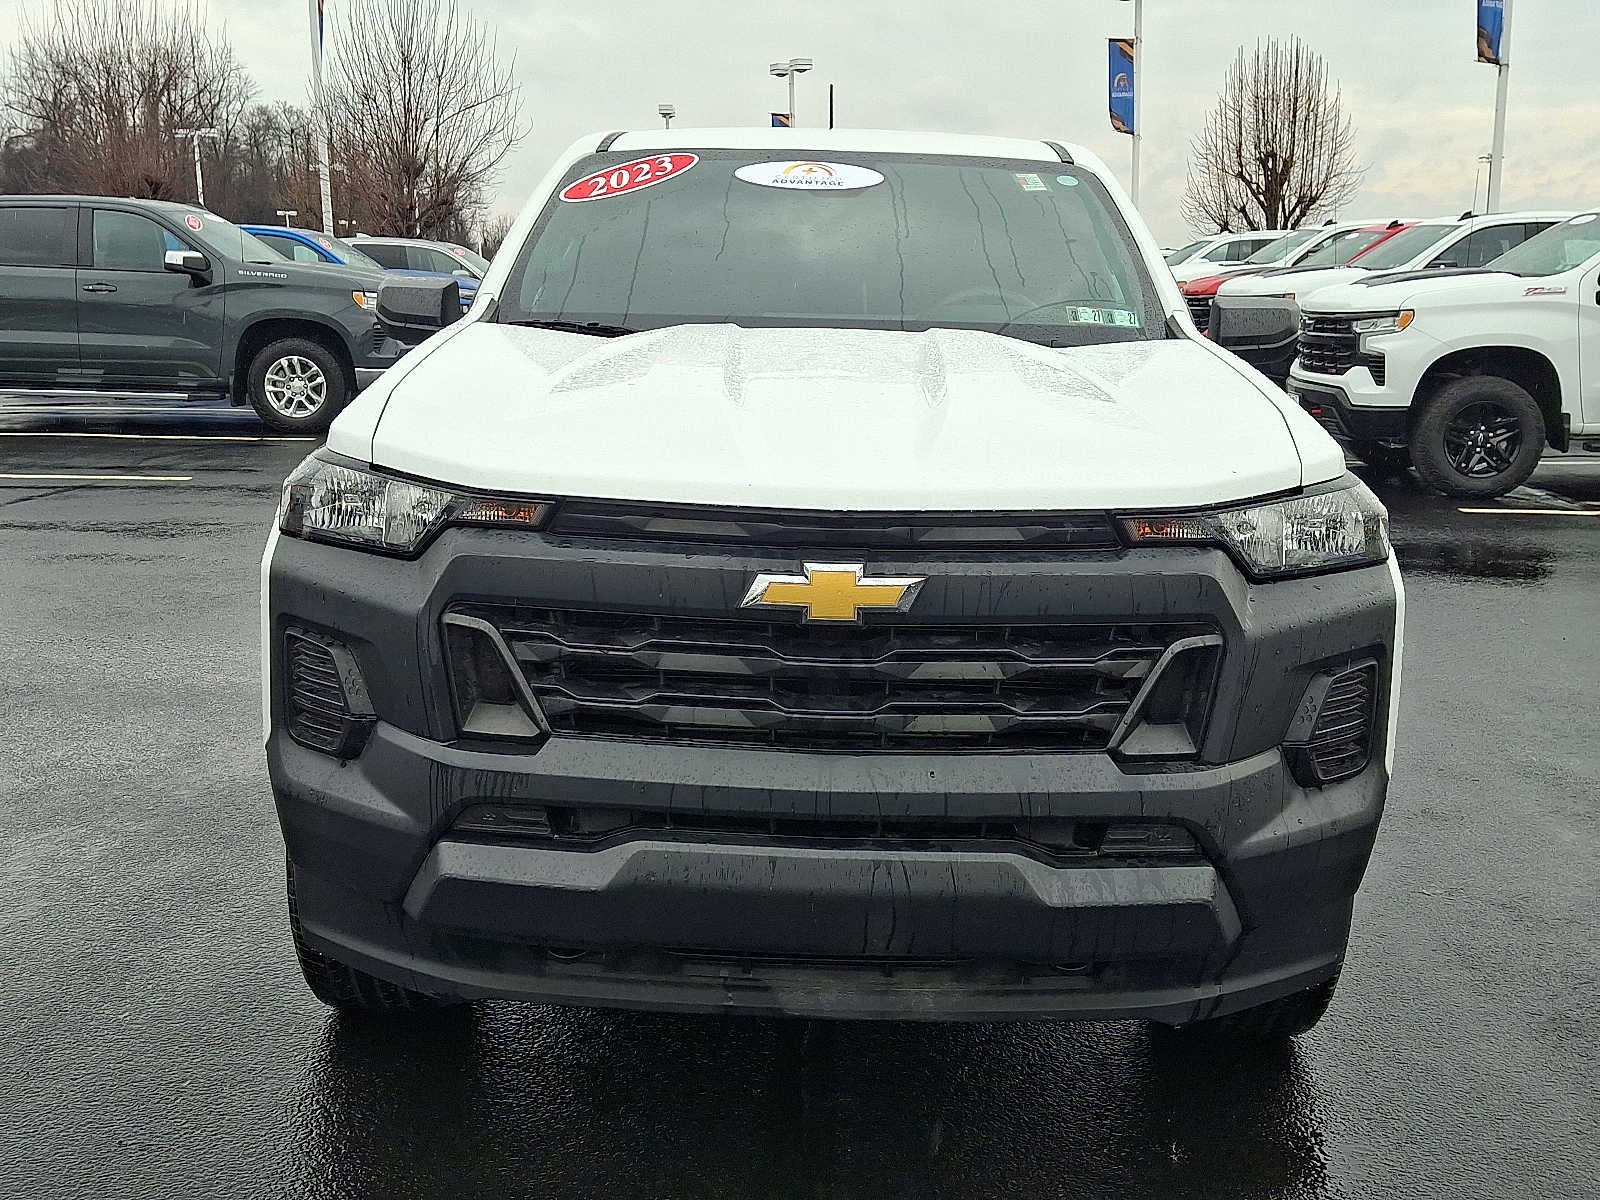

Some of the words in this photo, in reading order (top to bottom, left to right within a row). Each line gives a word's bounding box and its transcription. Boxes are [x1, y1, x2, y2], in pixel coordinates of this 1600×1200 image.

[588, 156, 673, 197] 2023
[771, 178, 844, 186] ADVANTAGE
[238, 270, 288, 279] SILVERADO
